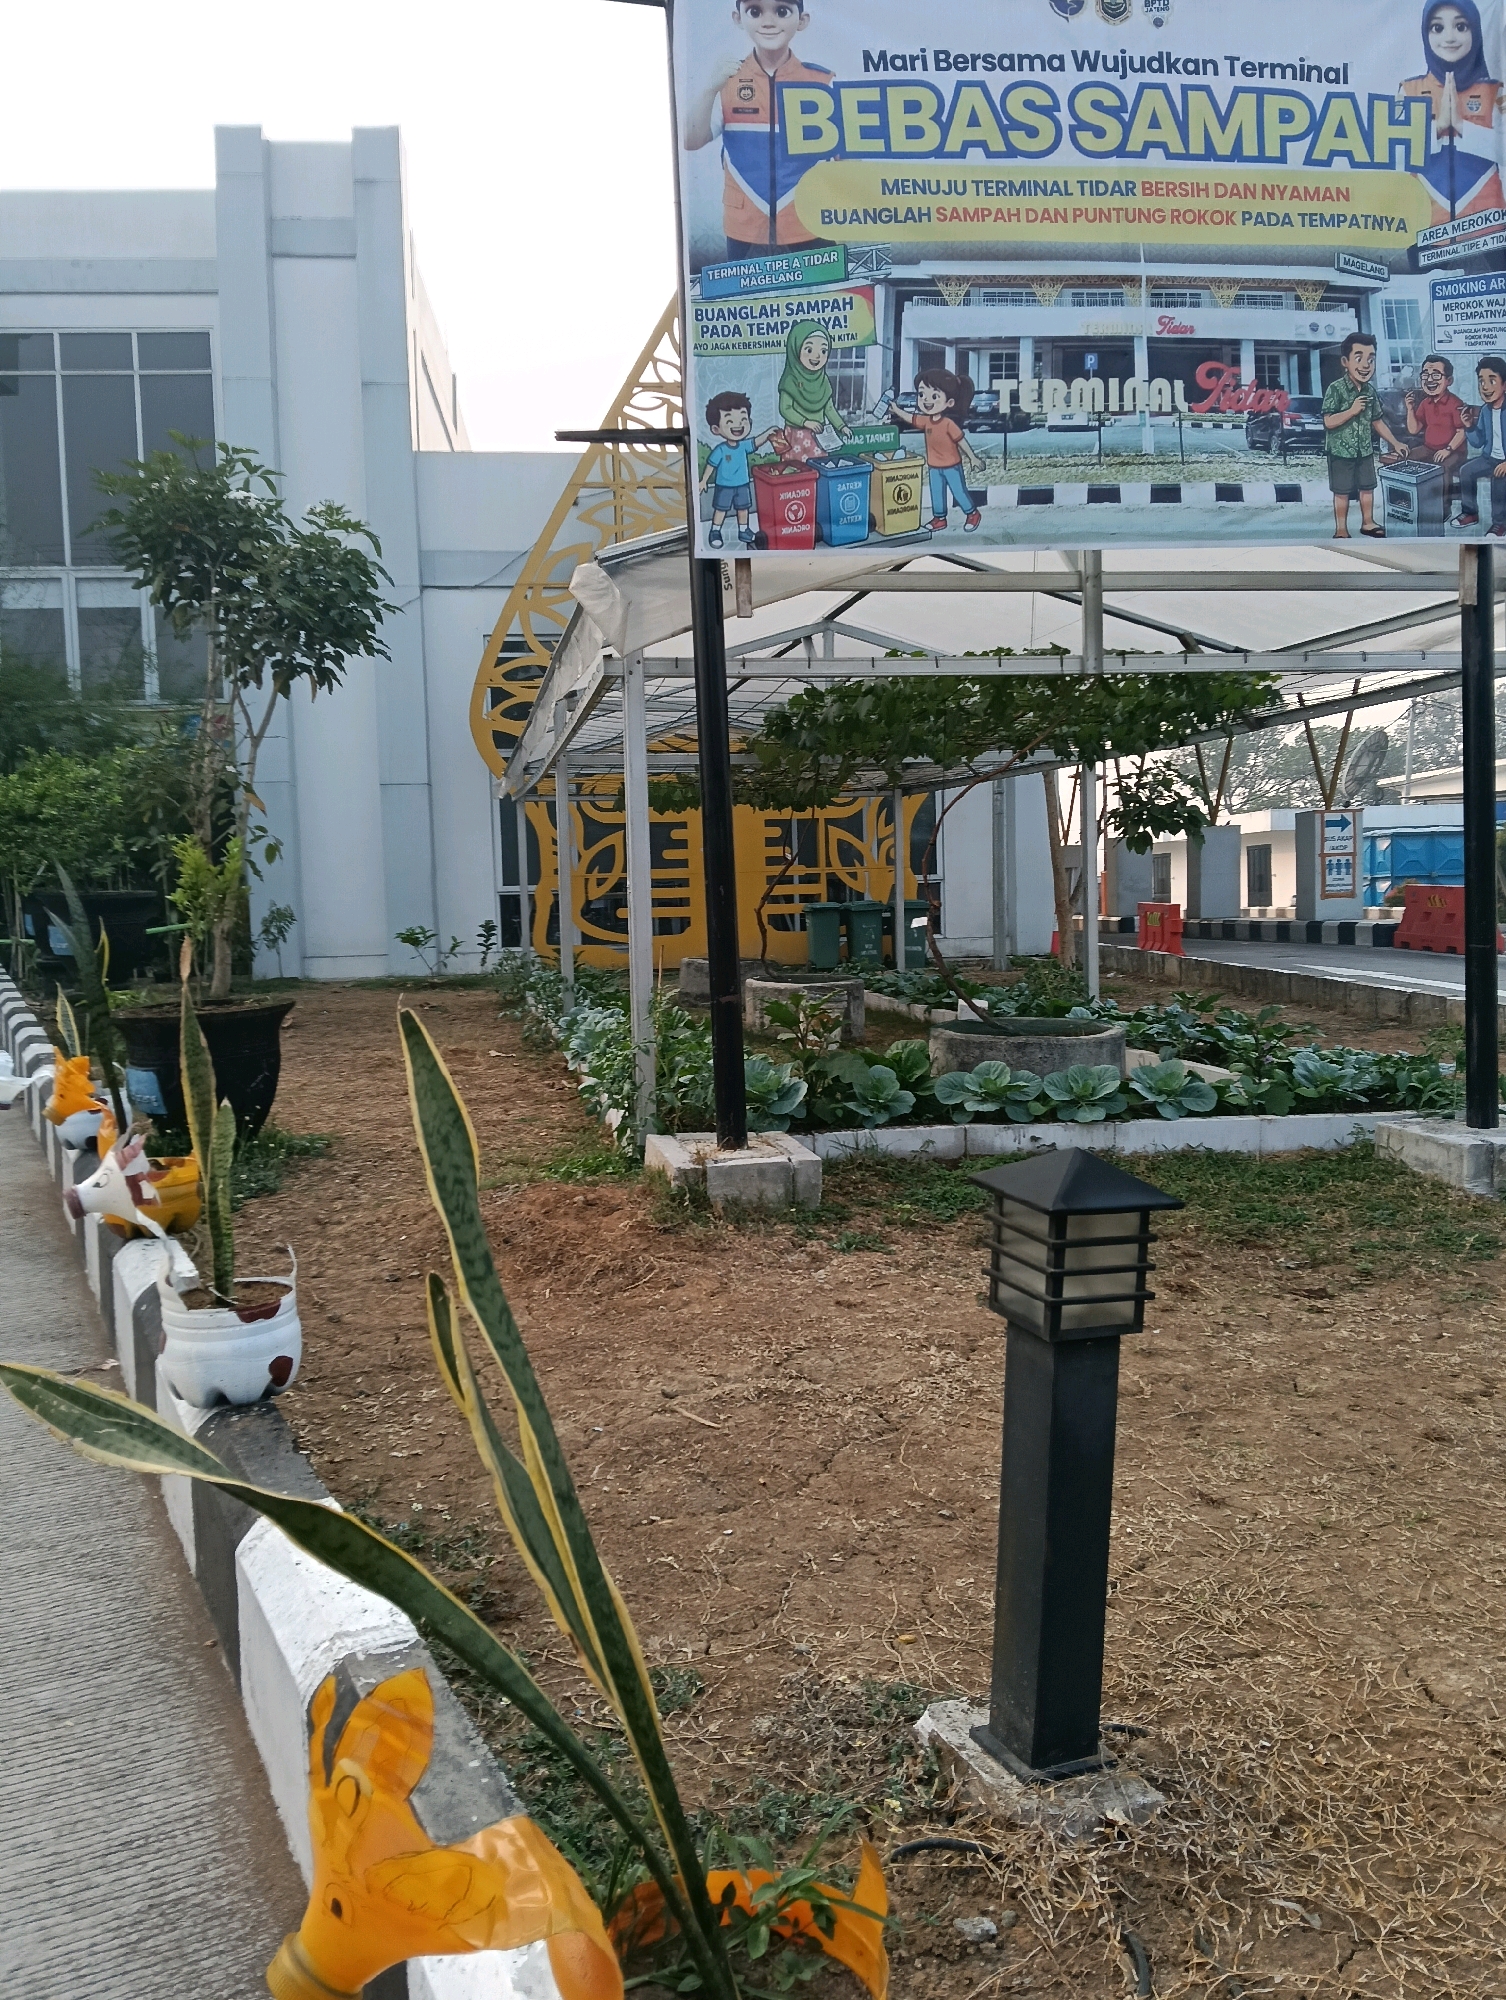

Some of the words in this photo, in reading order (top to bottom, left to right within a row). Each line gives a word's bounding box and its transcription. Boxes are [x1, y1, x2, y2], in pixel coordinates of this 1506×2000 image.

[863, 47, 928, 72] Mari
[933, 49, 1065, 72] Bersama
[1071, 48, 1219, 79] Wujudkan
[1224, 55, 1349, 85] Terminal
[779, 83, 1059, 157] BEBAS
[1071, 84, 1430, 169] SAMPAH
[881, 178, 967, 196] MENUJU
[971, 179, 1074, 197] TERMINAL
[1077, 180, 1137, 197] TIDAR
[1141, 180, 1210, 198] BERSIH
[1214, 182, 1257, 200] DAN
[1261, 183, 1350, 202] NYAMAN
[820, 206, 932, 225] BUANGLAH
[935, 206, 1021, 223] SAMPAH
[1025, 207, 1068, 224] DAN
[1072, 207, 1167, 225] PUNTUNG
[1170, 208, 1238, 226] ROKOK
[1241, 210, 1295, 228] PADA
[1298, 212, 1409, 233] TEMPATNYA
[1421, 226, 1450, 244] AREA
[1422, 248, 1461, 263] TERMINAL
[1462, 240, 1481, 253] TIPE
[1482, 239, 1489, 248] A
[707, 263, 763, 281] TERMINAL
[765, 259, 790, 272] TIPE
[792, 258, 801, 269] A
[802, 251, 839, 268] TIDAR
[1343, 256, 1386, 276] MAGELANG
[740, 272, 804, 289] MAGELANG
[1435, 279, 1487, 297] SMOKING
[694, 302, 781, 322] BUANGLAH
[785, 296, 854, 317] SAMPAH
[1442, 299, 1484, 312] MEROKOK
[1445, 313, 1453, 323] DI
[1455, 308, 1506, 322] TEMPATNYA
[700, 321, 743, 339] PADA
[746, 314, 848, 338] TEMPYA!
[1156, 314, 1196, 336] Tidar
[693, 341, 709, 351] AYO
[710, 341, 731, 351] JAGA
[837, 332, 859, 342] KITA!
[993, 376, 1189, 413] TERMINAL
[1191, 360, 1292, 414] Tidar
